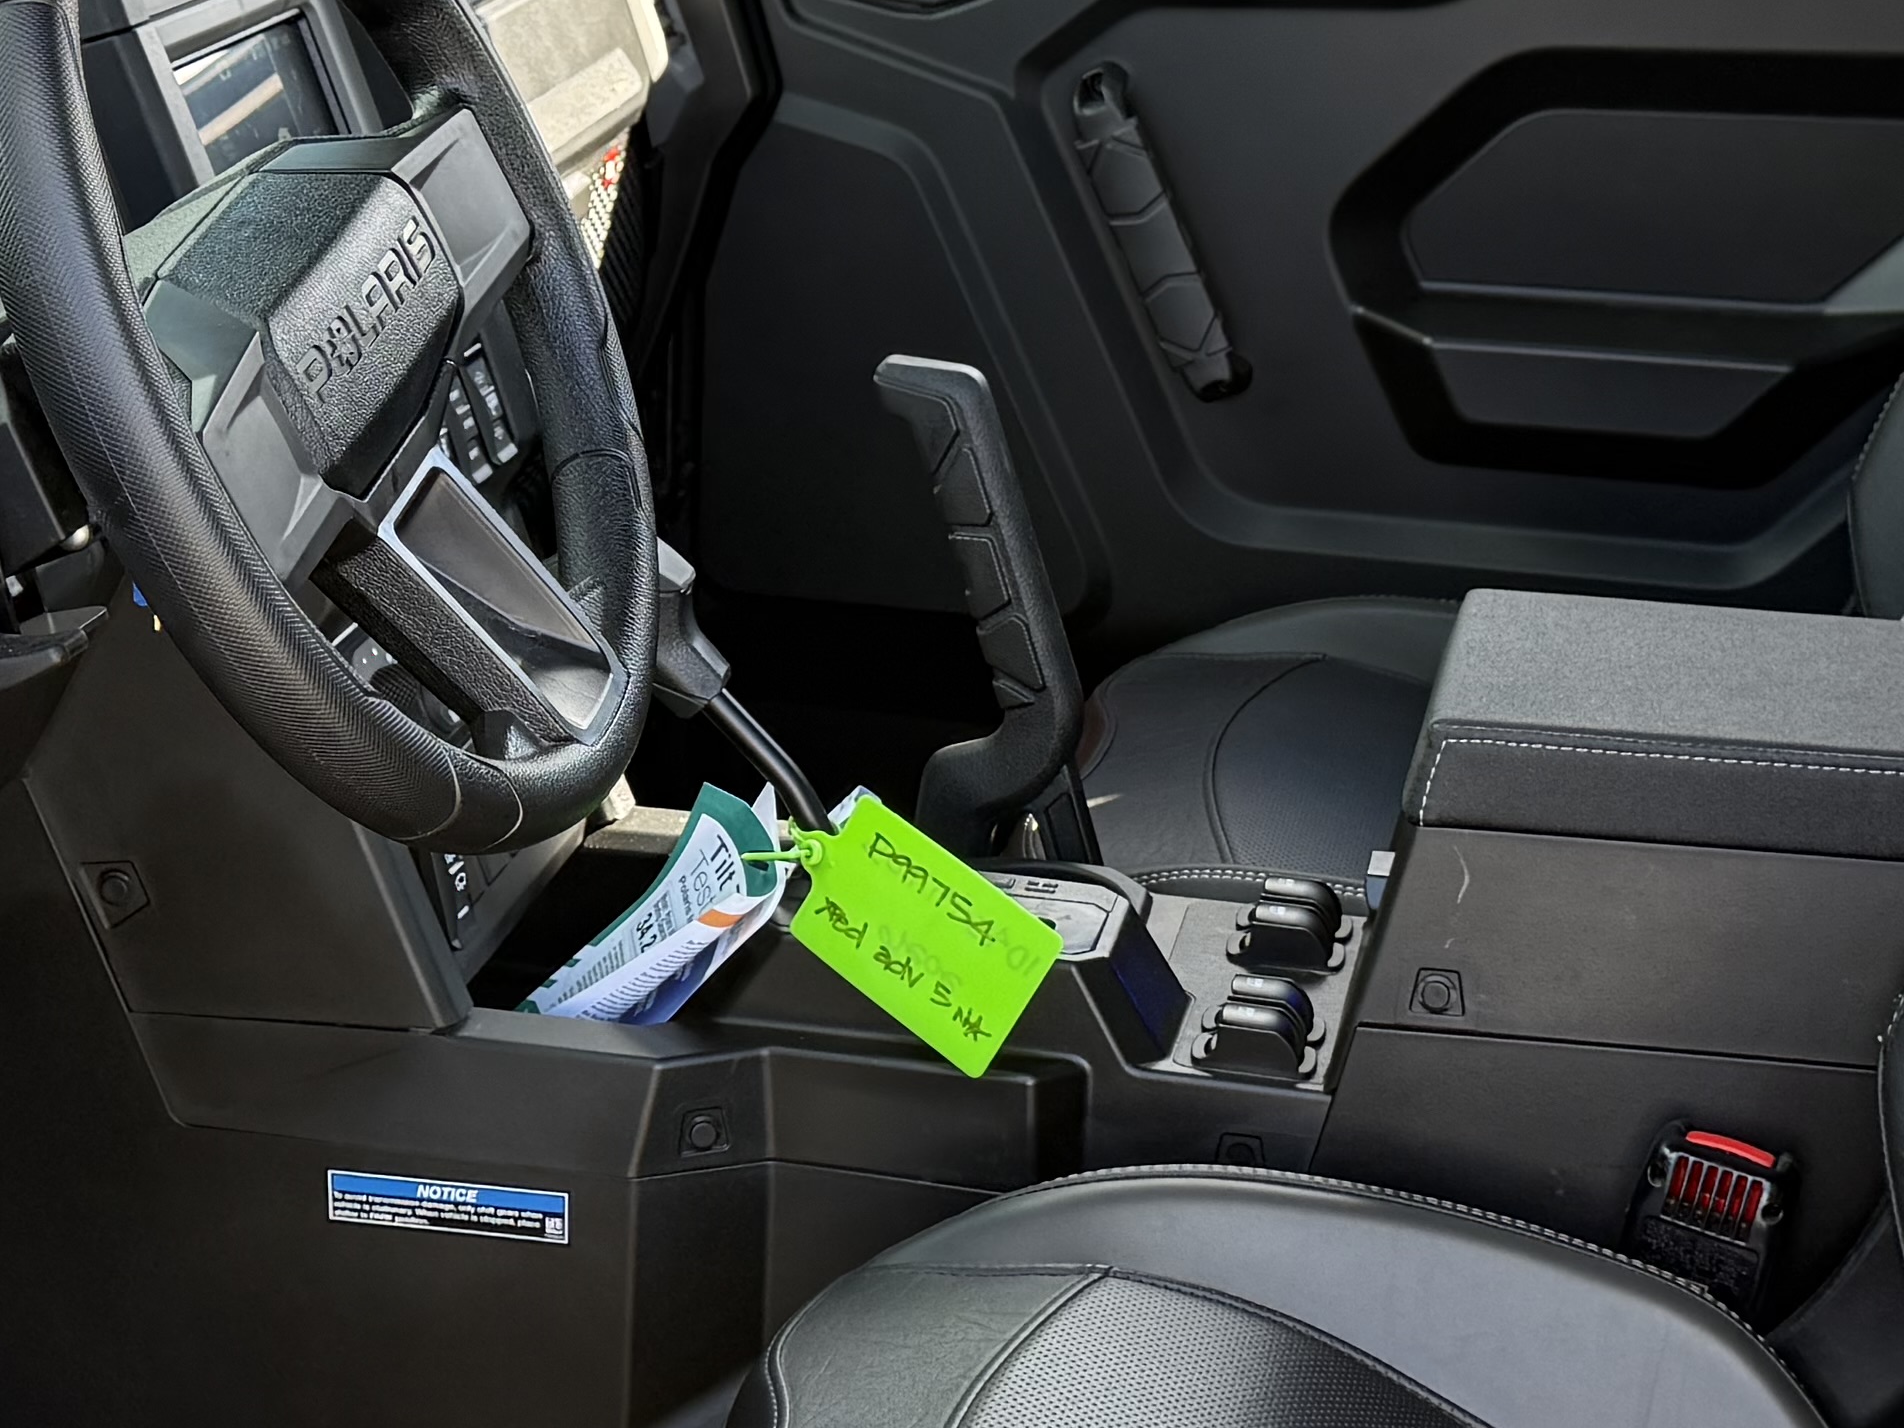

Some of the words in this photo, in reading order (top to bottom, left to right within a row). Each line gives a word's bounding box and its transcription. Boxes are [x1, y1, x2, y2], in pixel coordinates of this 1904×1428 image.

[296, 216, 436, 403] POLARIS
[710, 834, 734, 892] Tilt
[932, 981, 954, 1009] 5
[417, 1183, 479, 1203] NOTICE
